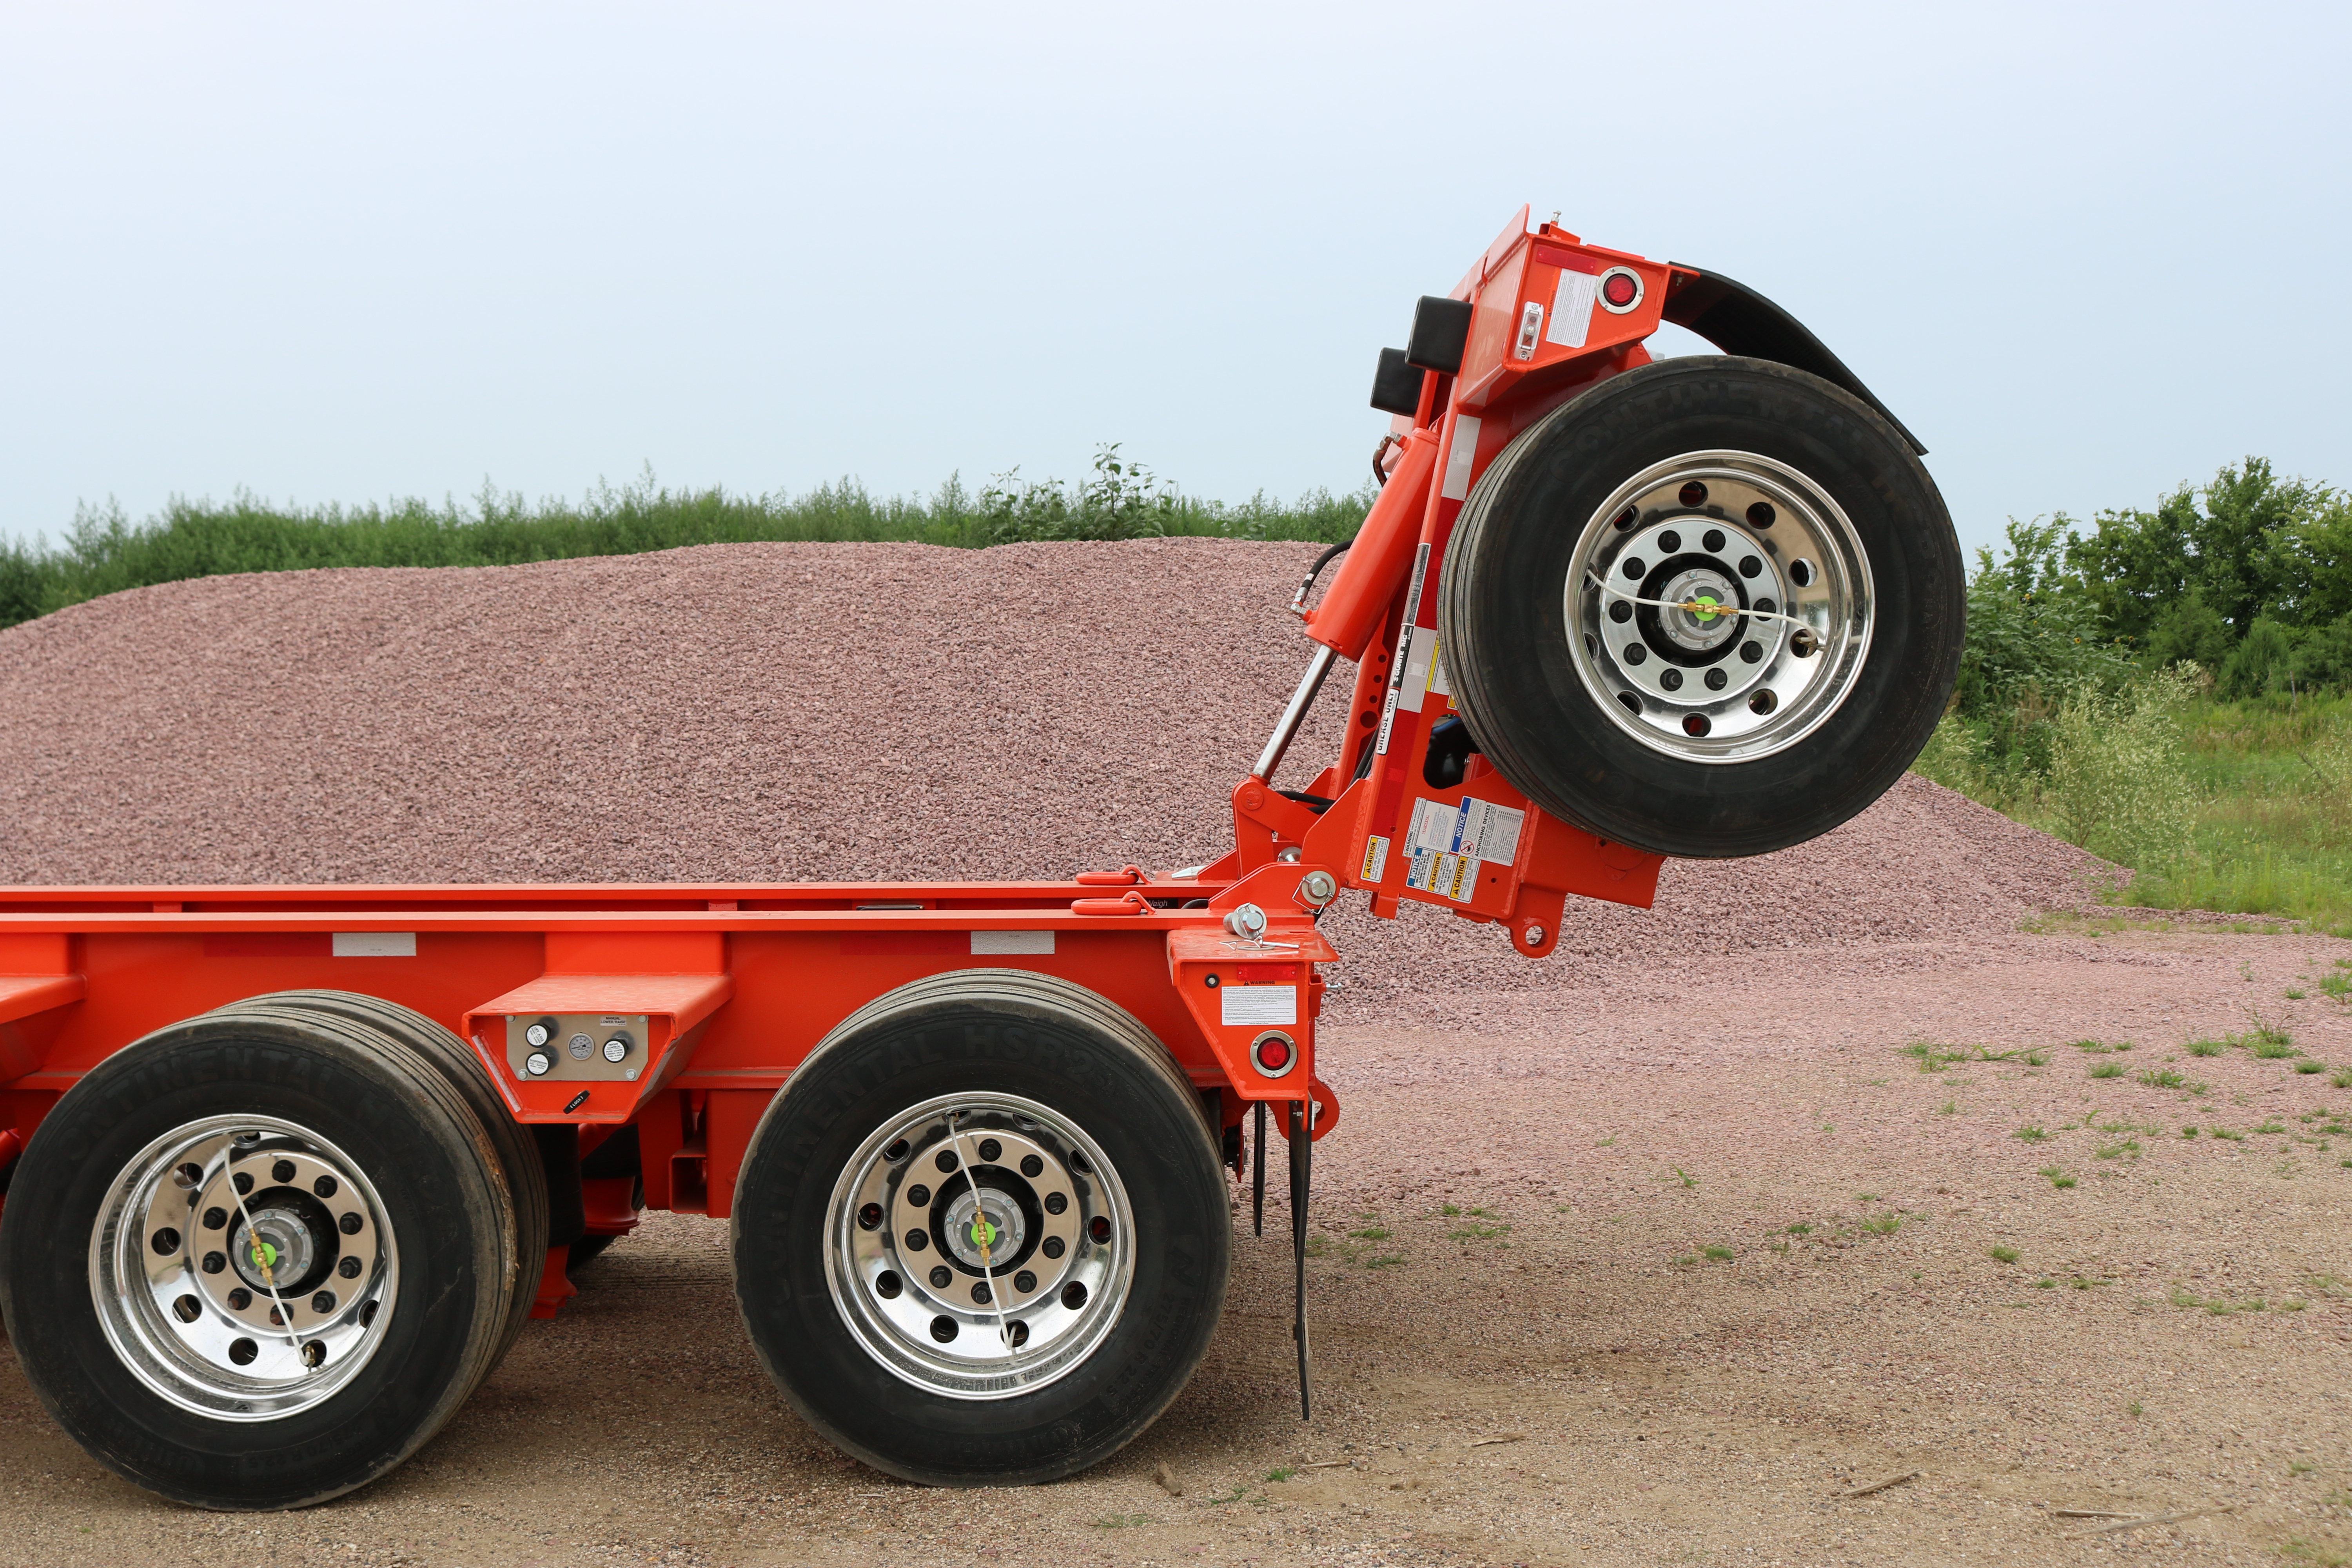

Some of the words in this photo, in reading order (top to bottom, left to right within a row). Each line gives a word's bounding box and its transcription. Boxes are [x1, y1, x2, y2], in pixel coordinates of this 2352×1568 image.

[1547, 289, 1557, 312] WARNING
[1545, 381, 1874, 487] CONTINENTAL
[1394, 650, 1405, 676] GUNITE
[1376, 716, 1389, 751] GREASE
[1384, 691, 1395, 713] ONLY
[1421, 814, 1430, 835] WARNING
[1455, 811, 1466, 838] NOTICE
[1474, 826, 1486, 857] ANCHORING
[1482, 804, 1491, 824] DEVICES
[1366, 841, 1376, 867] CAUTION
[1405, 830, 1414, 852] WARNING
[1409, 854, 1420, 879] NOTICE
[1431, 856, 1441, 881] CAUTION
[1454, 859, 1466, 888] CAUTION
[964, 1023, 1096, 1087] HSR2
[571, 1097, 581, 1107] LOCK
[42, 1045, 346, 1193] CONTINENTAL
[756, 1030, 944, 1308] CONTINENTAL
[1140, 1290, 1180, 1353] 275/70
[1132, 1348, 1151, 1367] R
[1102, 1361, 1141, 1400] 22.5
